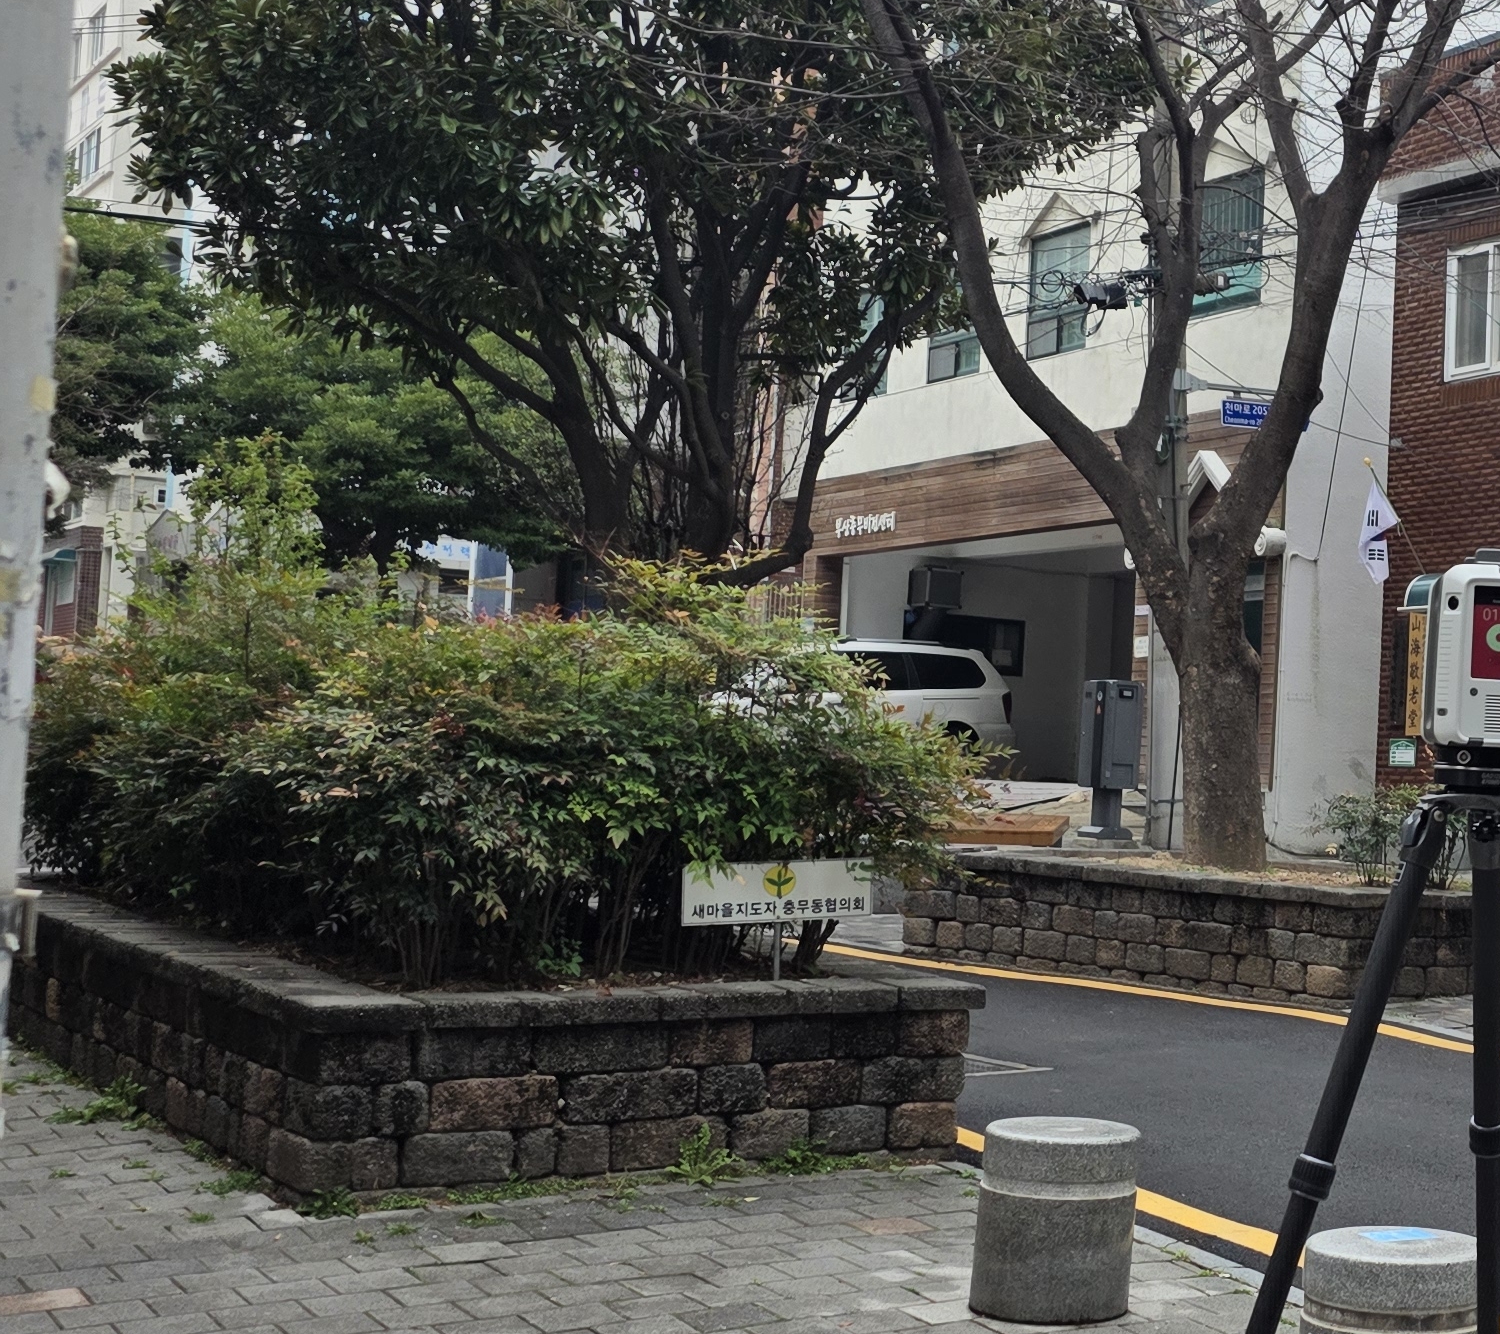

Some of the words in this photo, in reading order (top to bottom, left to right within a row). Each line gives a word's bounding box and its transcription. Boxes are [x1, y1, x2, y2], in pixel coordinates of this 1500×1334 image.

[1225, 402, 1252, 415] 천마로
[1252, 405, 1270, 416] 205
[691, 900, 777, 919] 새마을지도자
[782, 896, 865, 915] 충무동협의회
